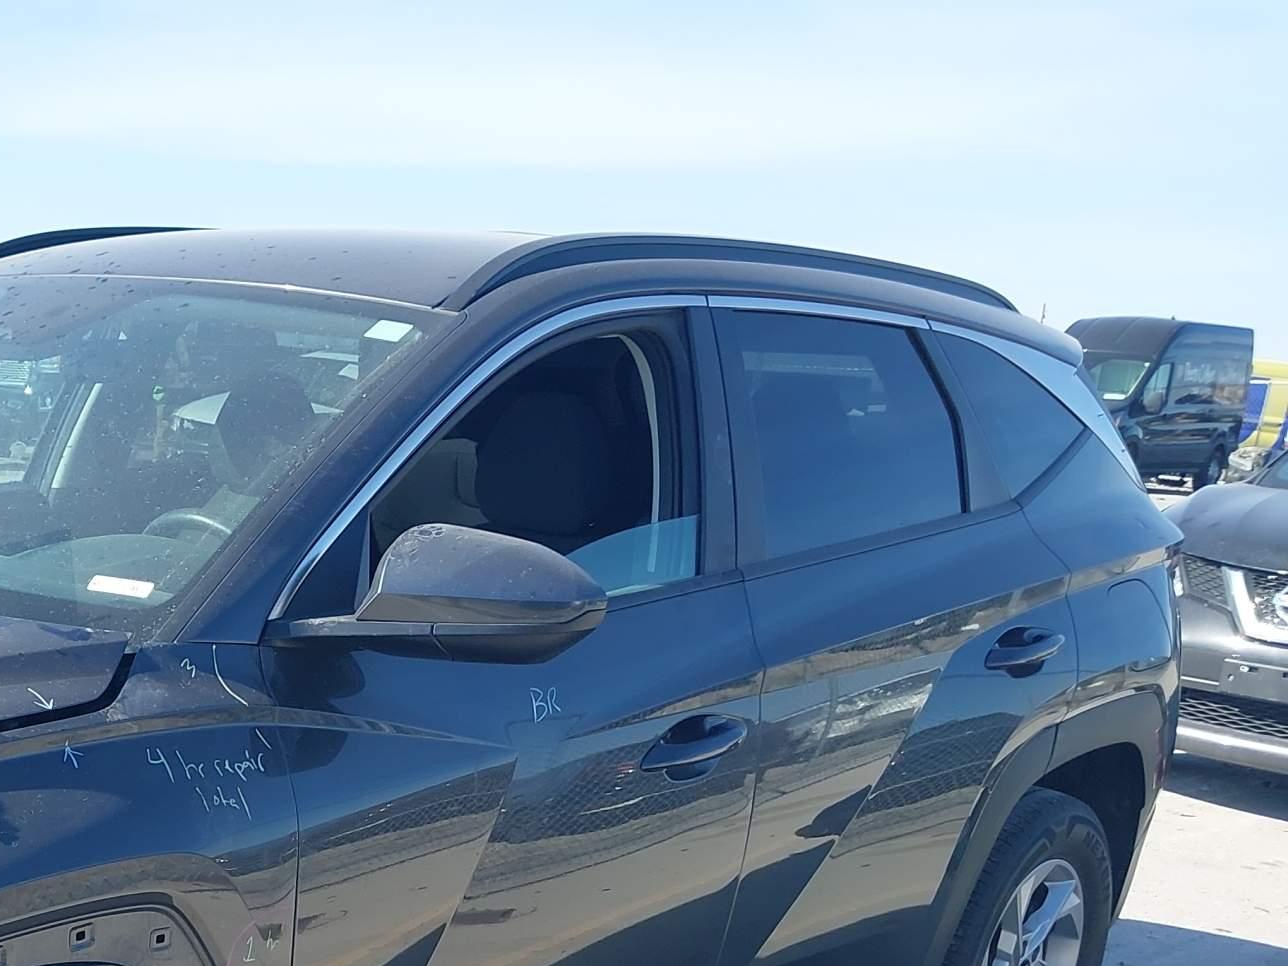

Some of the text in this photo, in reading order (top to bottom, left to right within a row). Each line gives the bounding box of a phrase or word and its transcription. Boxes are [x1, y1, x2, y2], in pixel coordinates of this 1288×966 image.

[529, 686, 561, 724] BR
[146, 747, 265, 783] 4 hr repair
